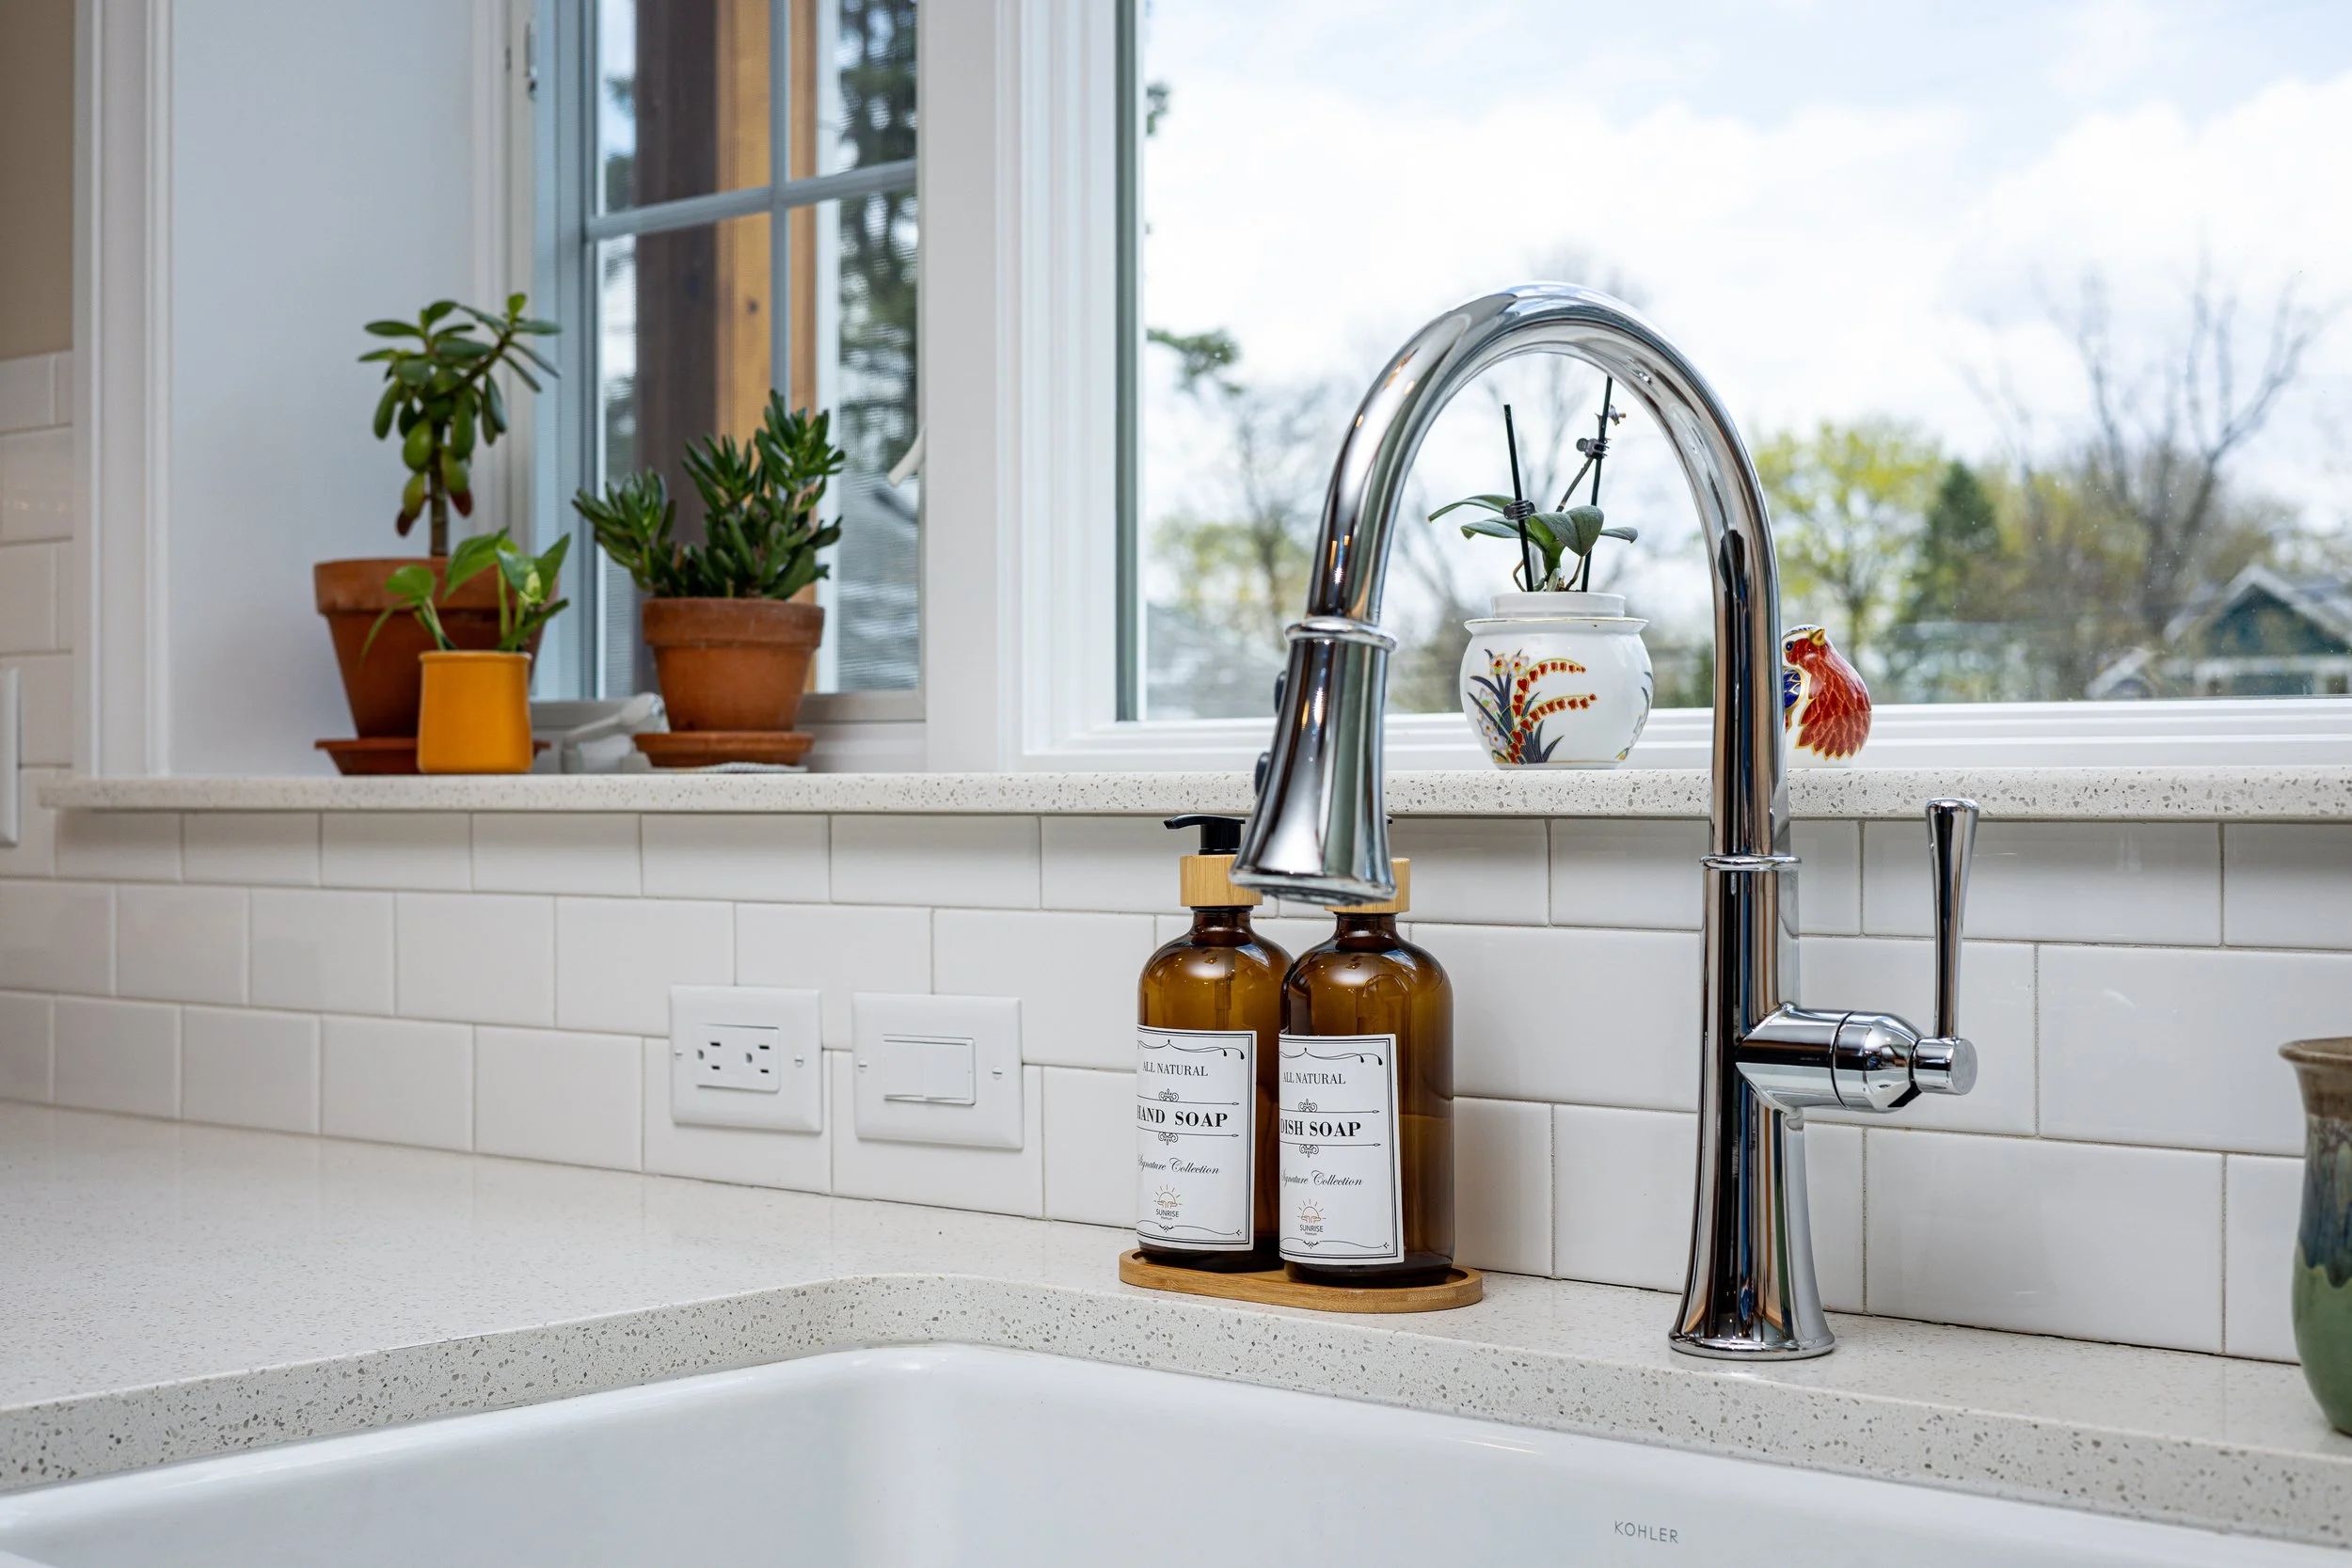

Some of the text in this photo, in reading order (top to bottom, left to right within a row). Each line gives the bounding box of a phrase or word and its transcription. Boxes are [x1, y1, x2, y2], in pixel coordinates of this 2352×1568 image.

[1142, 1061, 1209, 1077] ALL NATURAL
[1283, 1072, 1346, 1085] ALL NATURAL
[1136, 1104, 1229, 1128] HAND SOAP
[1280, 1118, 1361, 1137] DISH SOAP
[1168, 1156, 1220, 1175] Collection
[1311, 1169, 1363, 1186] Collection
[1155, 1208, 1180, 1218] SUNRISE
[1299, 1224, 1324, 1233] SUNRISE
[1613, 1520, 1679, 1544] KOHLER
